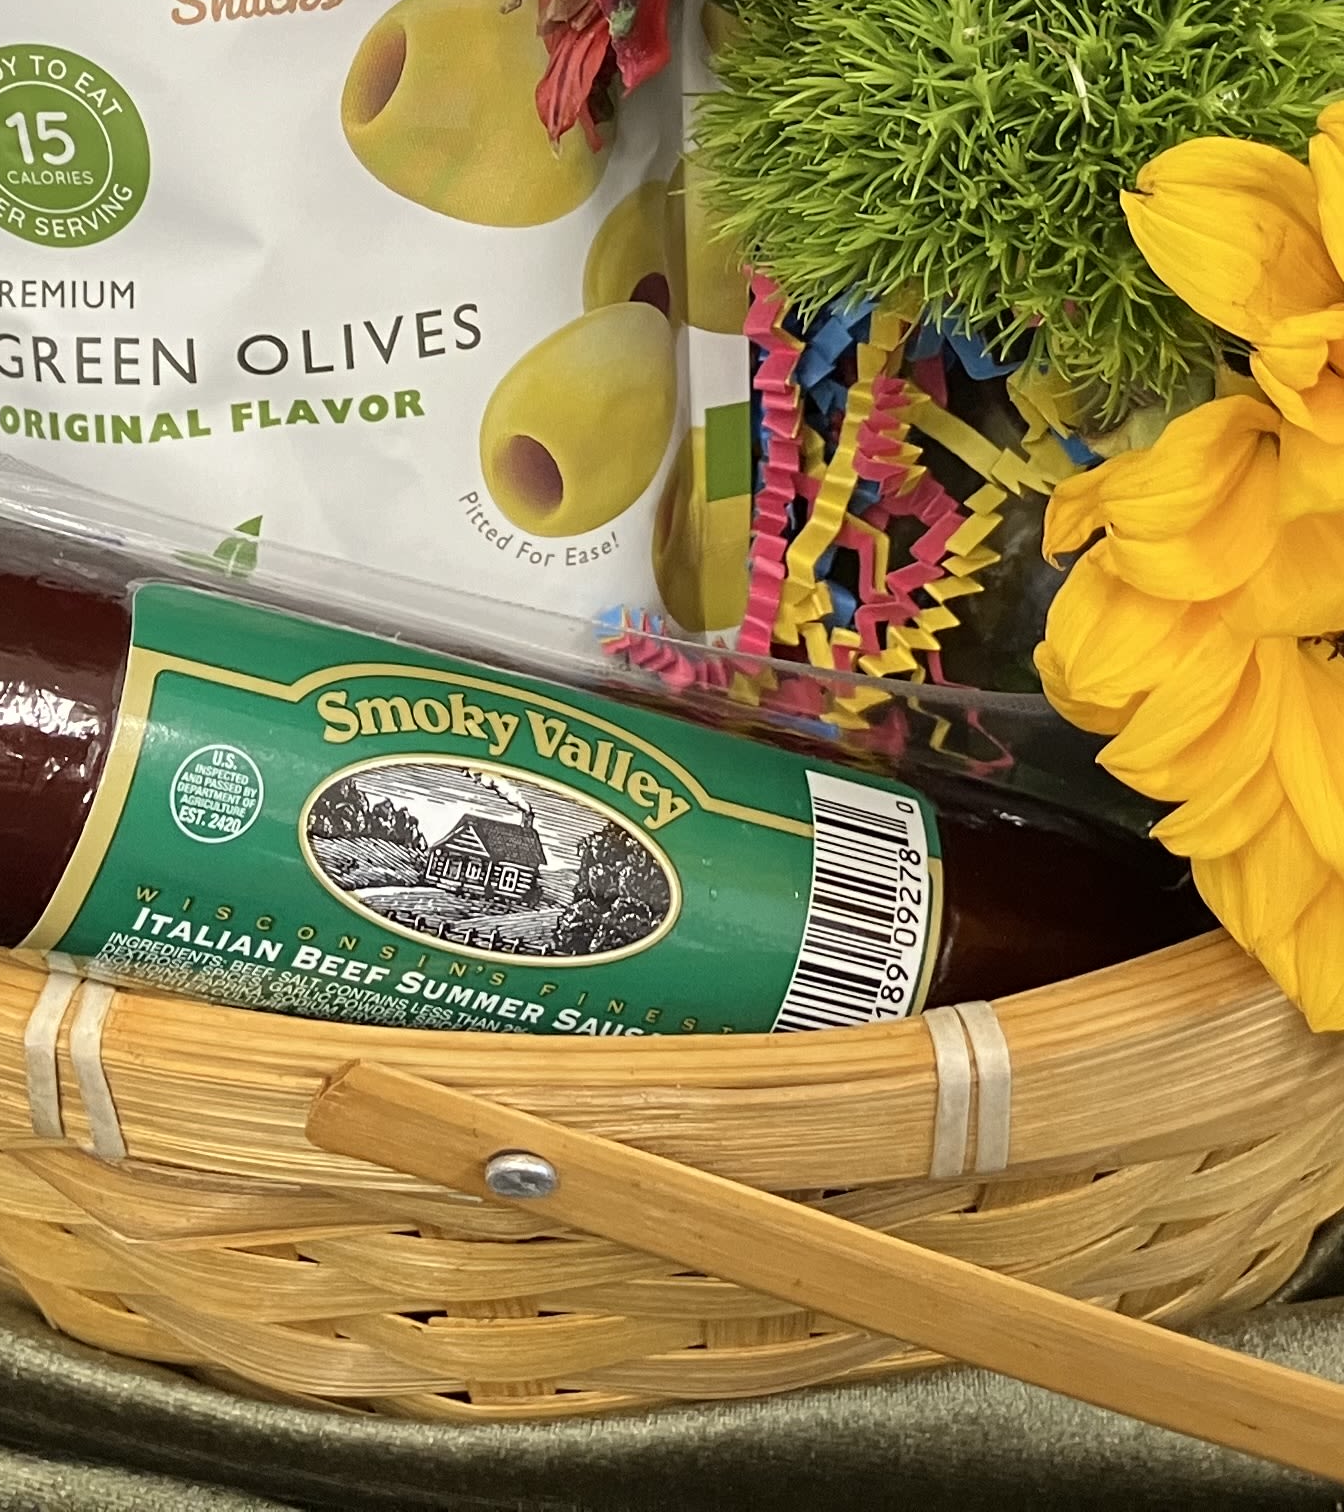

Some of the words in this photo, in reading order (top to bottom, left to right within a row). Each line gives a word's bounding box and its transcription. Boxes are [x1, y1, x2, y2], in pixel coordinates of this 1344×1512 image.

[29, 55, 67, 80] TO
[74, 71, 123, 116] EAT
[5, 111, 76, 166] 15
[6, 170, 94, 185] CALORIES
[34, 183, 134, 238] SERVING
[236, 303, 483, 376] OLIVES
[230, 389, 426, 434] FLAVOR
[458, 490, 514, 551] Pitted
[516, 541, 555, 567] For
[565, 531, 620, 567] Ease!
[181, 771, 203, 785] AND
[204, 777, 242, 794] PASSED
[242, 786, 257, 798] BY
[194, 763, 249, 785] INSPECTED
[212, 750, 237, 770] U.S.
[316, 690, 520, 757] Smoky
[524, 709, 691, 831] Valley
[177, 781, 241, 805] DEPARTMENT
[242, 797, 256, 808] OF
[179, 805, 206, 826] EST.
[207, 812, 242, 833] 2420
[180, 794, 247, 818] AGRICULTURE
[136, 886, 505, 986] WISCONSIN'S
[108, 932, 228, 968] INGREDIENTS:
[326, 982, 410, 1011] CONTAINS
[410, 1001, 454, 1021] LESS
[457, 1012, 502, 1032] THAN
[132, 907, 284, 962] ITALIAN
[291, 945, 391, 985] BEEF
[394, 971, 545, 1025] SUMMER
